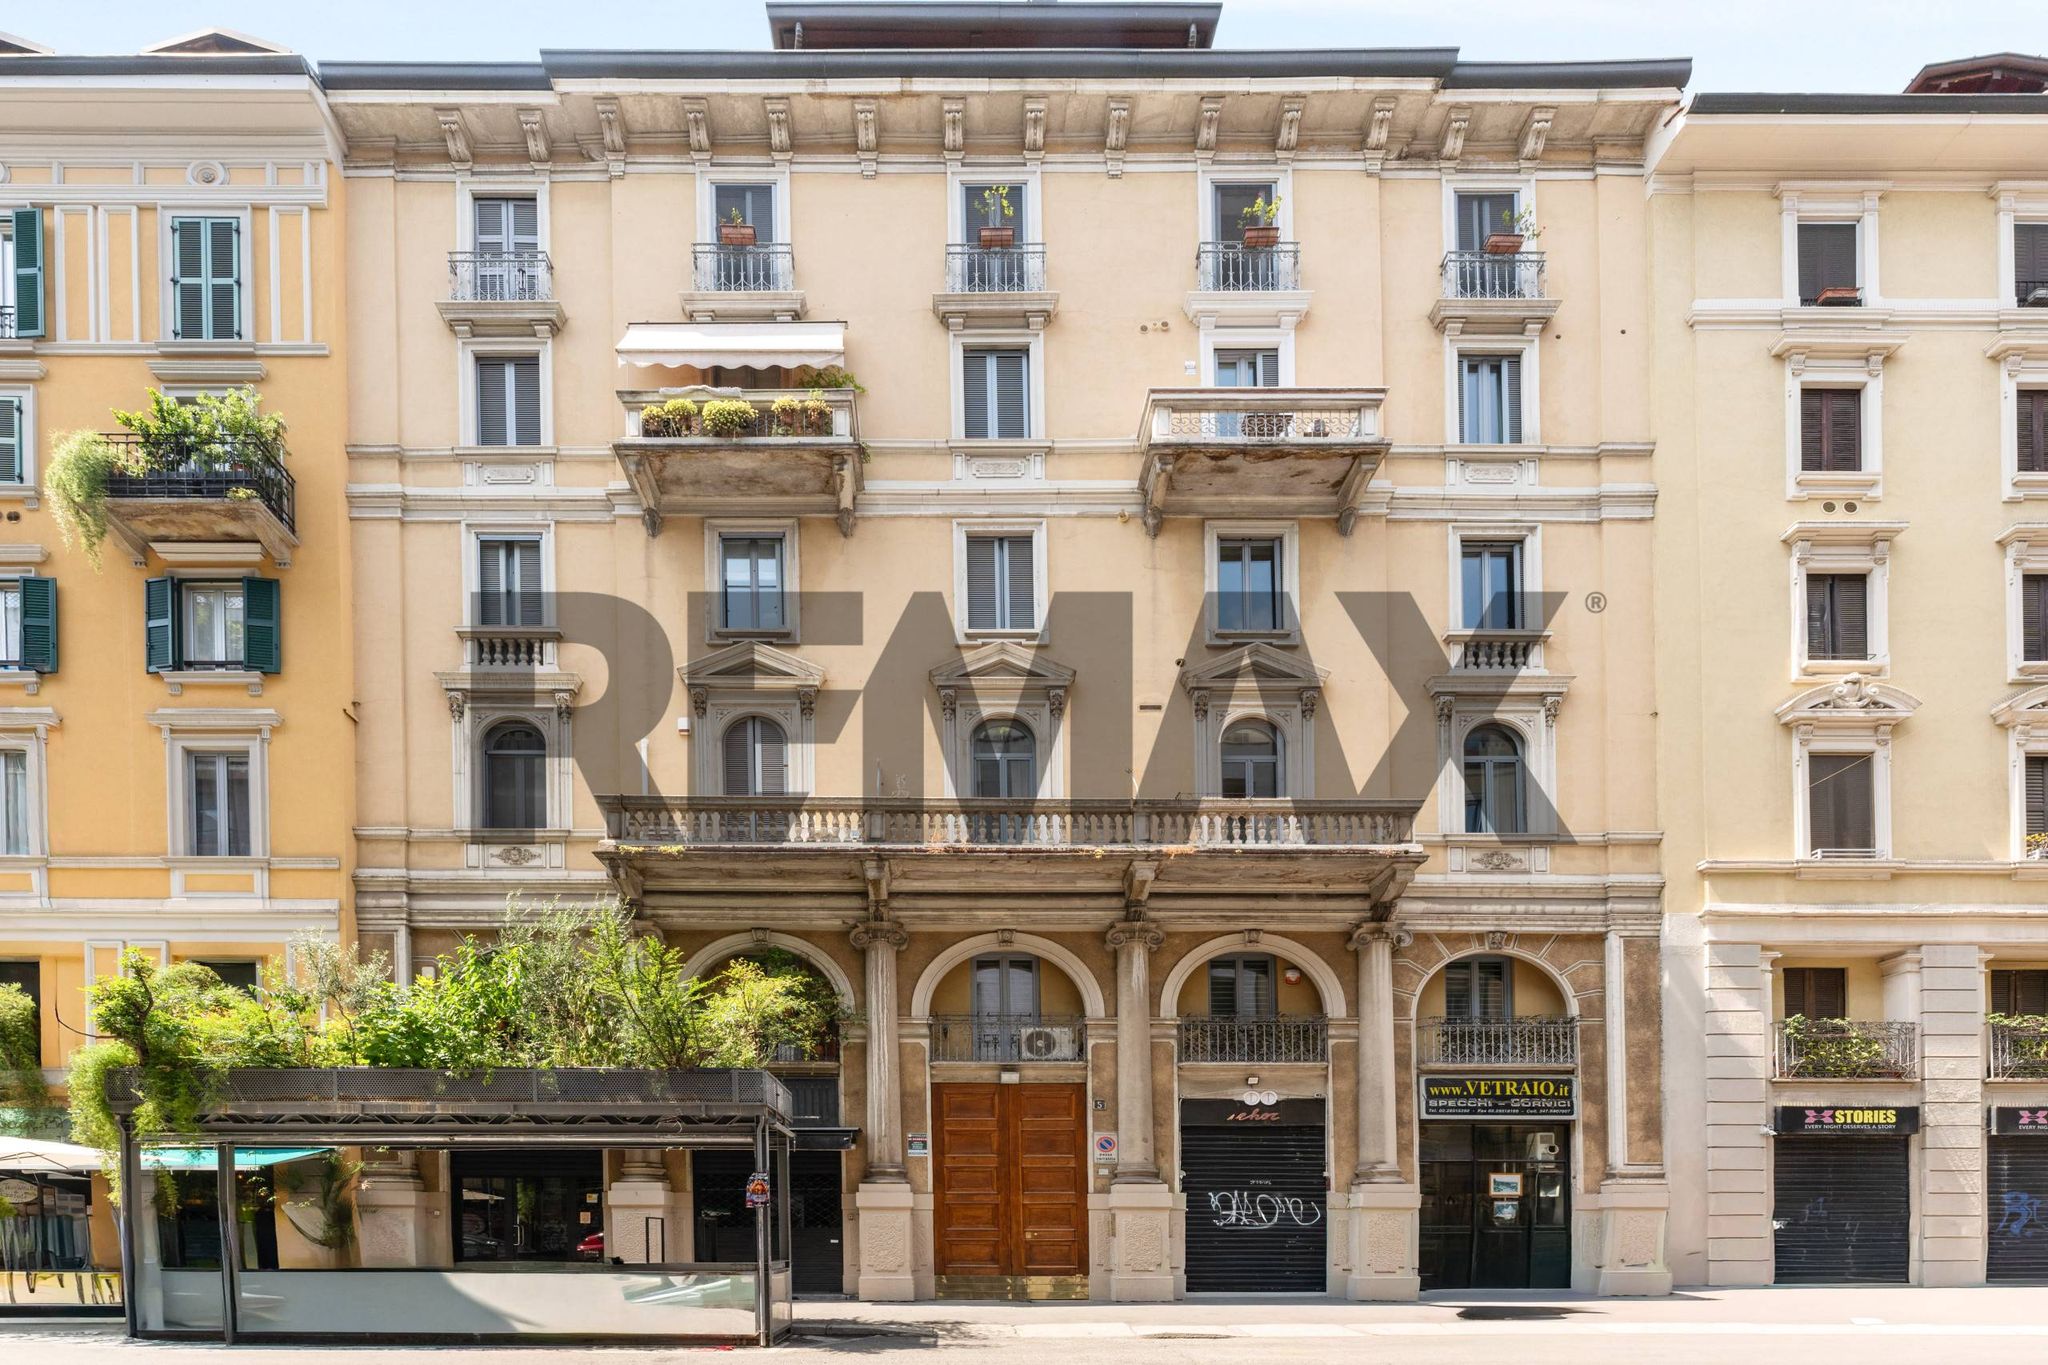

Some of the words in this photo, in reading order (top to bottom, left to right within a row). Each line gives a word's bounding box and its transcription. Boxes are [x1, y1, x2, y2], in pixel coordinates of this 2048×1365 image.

[1429, 1080, 1569, 1096] www.VETRAIO.it
[1429, 1098, 1492, 1107] SPECCHI
[1835, 1109, 1896, 1124] STORIES
